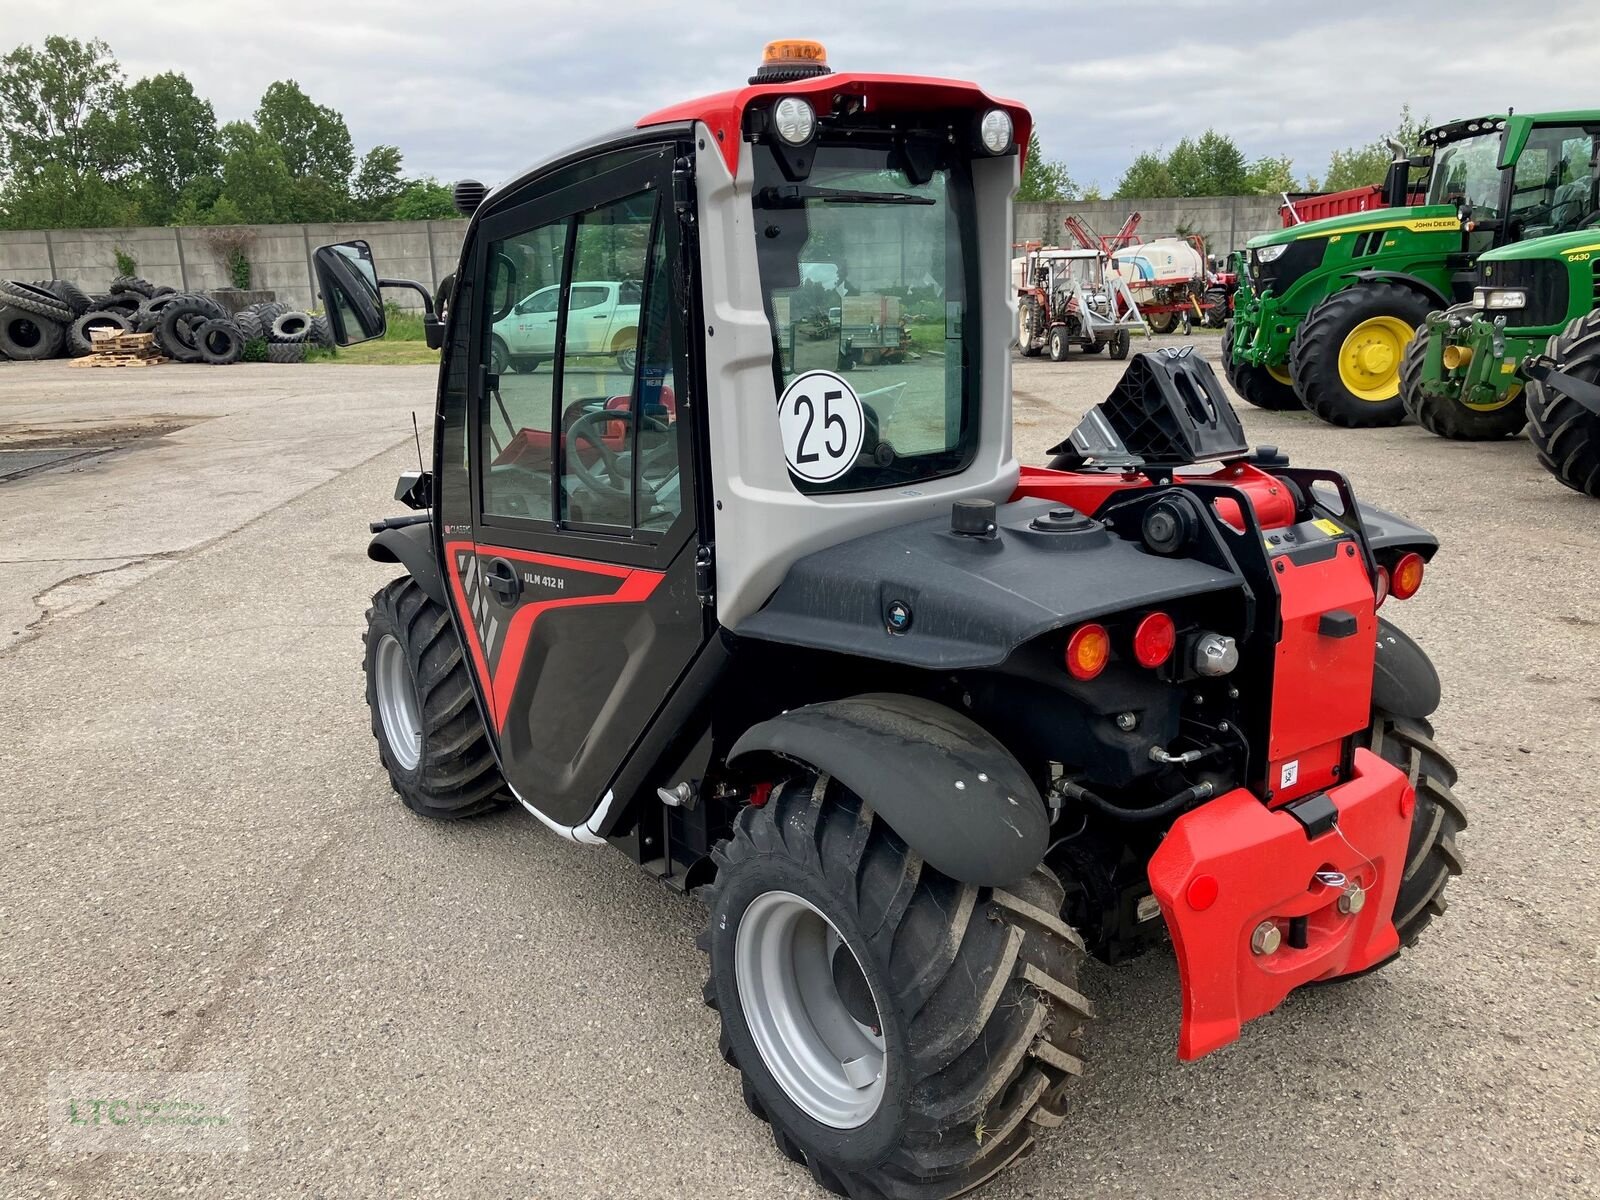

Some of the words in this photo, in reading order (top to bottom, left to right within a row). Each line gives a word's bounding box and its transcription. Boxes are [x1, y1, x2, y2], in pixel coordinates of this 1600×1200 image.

[1414, 221, 1433, 229] JOHN
[1434, 220, 1456, 228] DEERE
[1568, 253, 1591, 262] 6430
[794, 390, 848, 464] 25
[524, 573, 541, 585] ULM
[541, 576, 557, 588] 412
[557, 579, 565, 589] H
